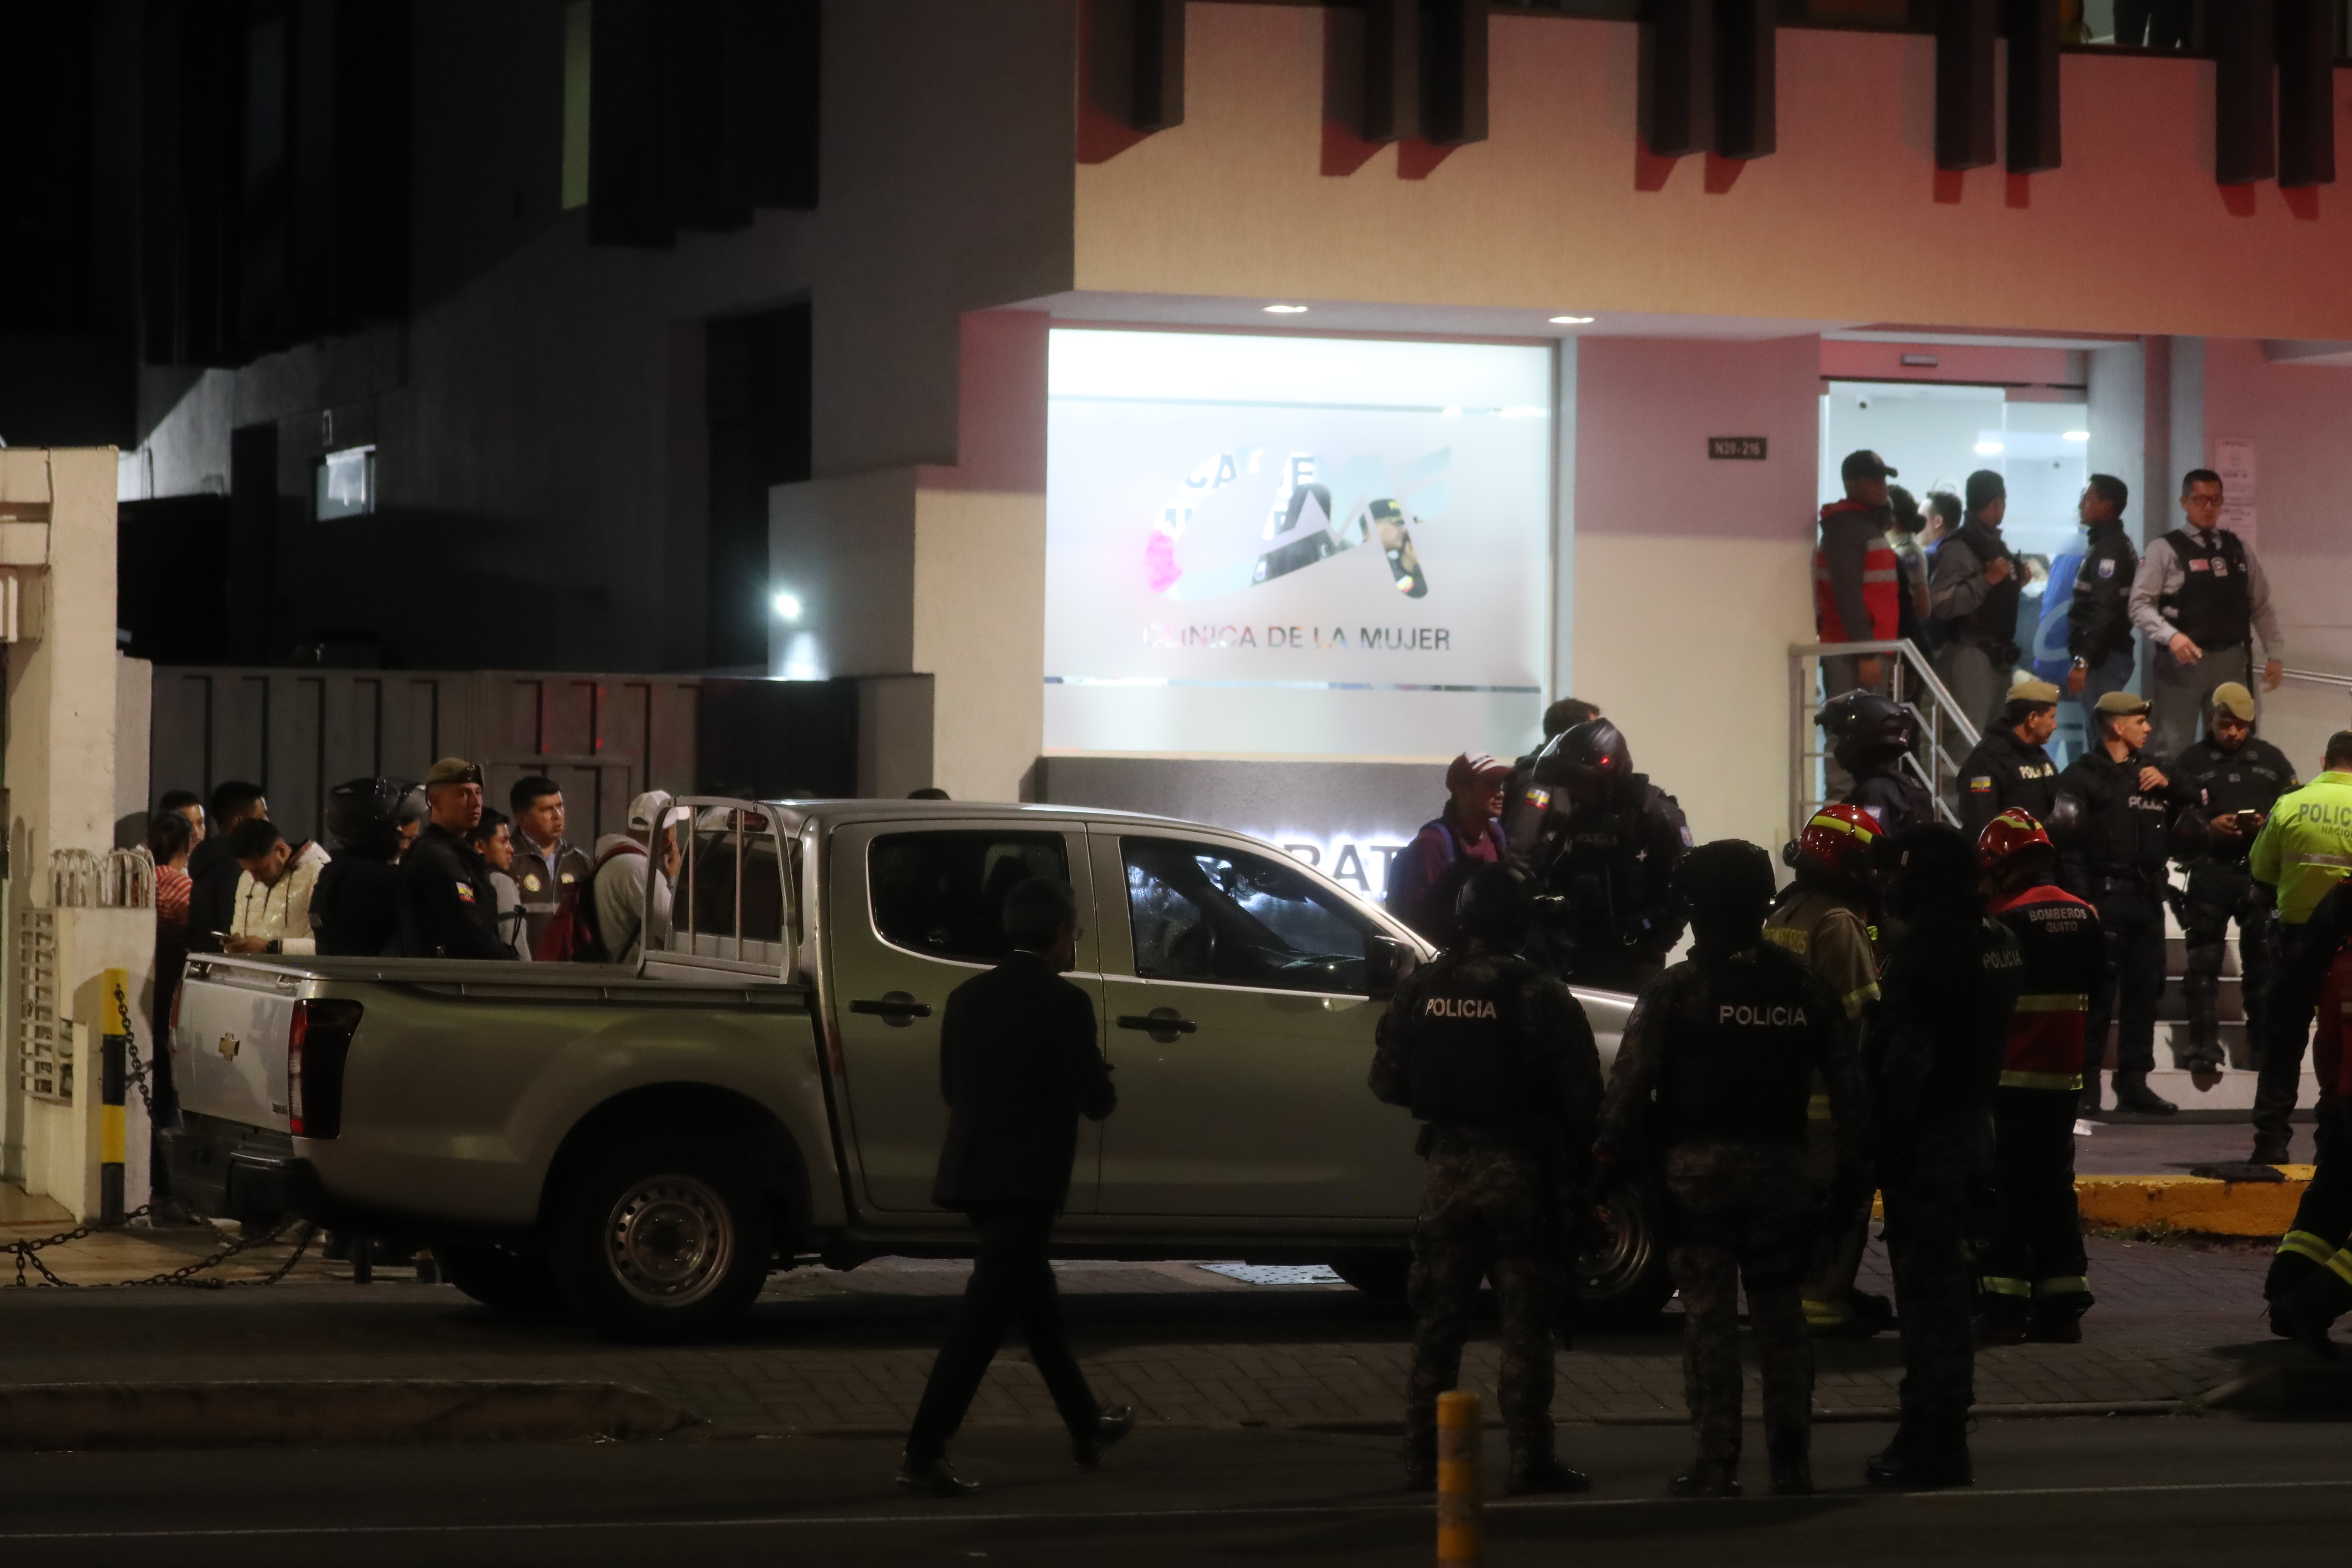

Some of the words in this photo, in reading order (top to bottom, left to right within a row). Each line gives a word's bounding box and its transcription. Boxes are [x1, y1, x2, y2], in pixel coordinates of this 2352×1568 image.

[1267, 625, 1304, 648] DE
[1313, 626, 1349, 649] LA
[1360, 626, 1451, 650] MUJER
[2321, 825, 2352, 838] NACIO
[2028, 907, 2088, 922] BOMBEROS
[2046, 921, 2078, 933] QUITO
[1982, 949, 2022, 970] POLICIA
[1425, 997, 1498, 1019] POLICIA
[1719, 1005, 1808, 1026] POLICIA
